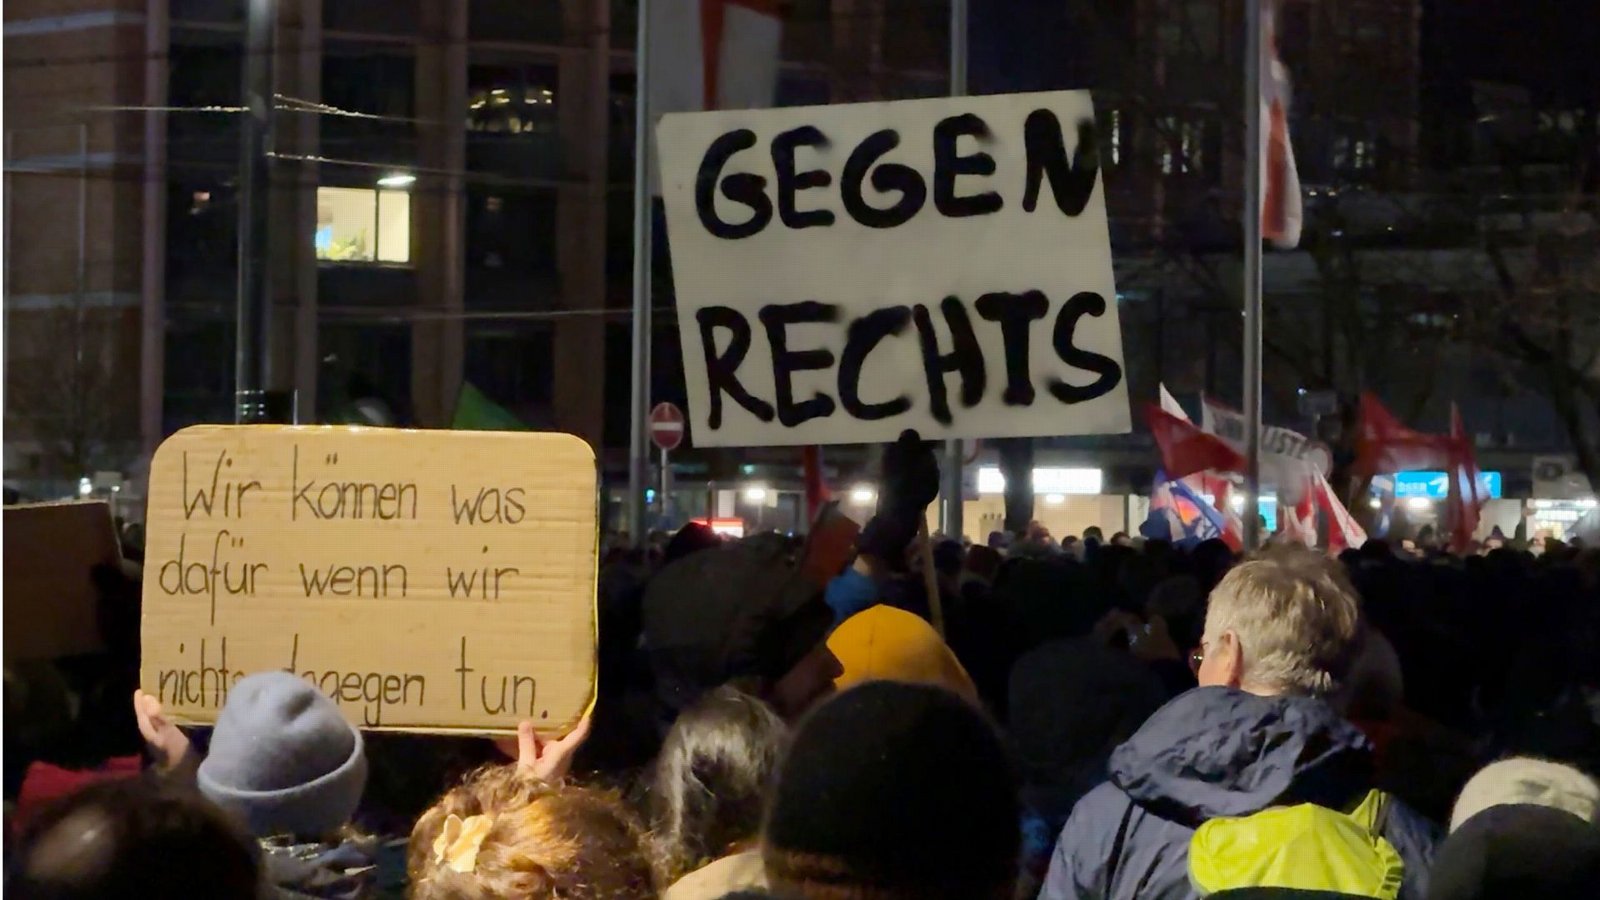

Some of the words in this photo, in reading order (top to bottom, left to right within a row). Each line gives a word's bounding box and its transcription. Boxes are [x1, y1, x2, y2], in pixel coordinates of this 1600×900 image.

[695, 108, 1099, 239] GEGEN
[695, 289, 1122, 430] RECHTS
[182, 448, 262, 521] Wir
[292, 443, 417, 522] können
[452, 482, 526, 525] was
[159, 529, 269, 626] dafür
[299, 562, 407, 598] wenn
[447, 545, 520, 599] wir
[455, 635, 549, 719] tun.
